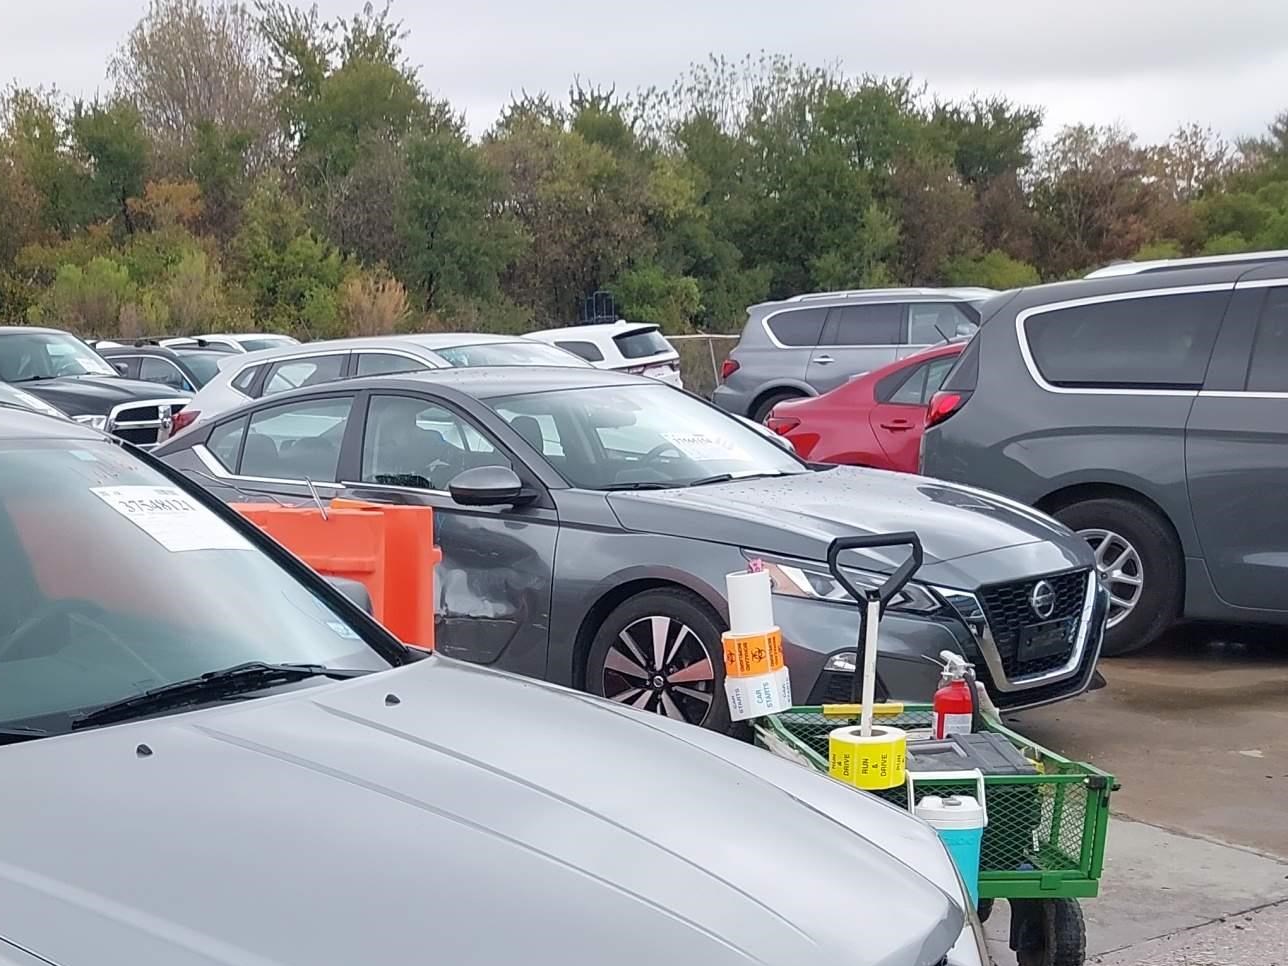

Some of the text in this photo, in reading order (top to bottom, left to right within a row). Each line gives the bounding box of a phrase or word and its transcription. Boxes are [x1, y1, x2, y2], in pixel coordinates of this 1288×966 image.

[119, 499, 198, 513] 37548121
[755, 689, 765, 704] CAR
[762, 681, 774, 708] STARTS
[843, 753, 851, 776] DRIVE
[861, 758, 869, 775] RUN
[880, 753, 888, 777] DRIVE
